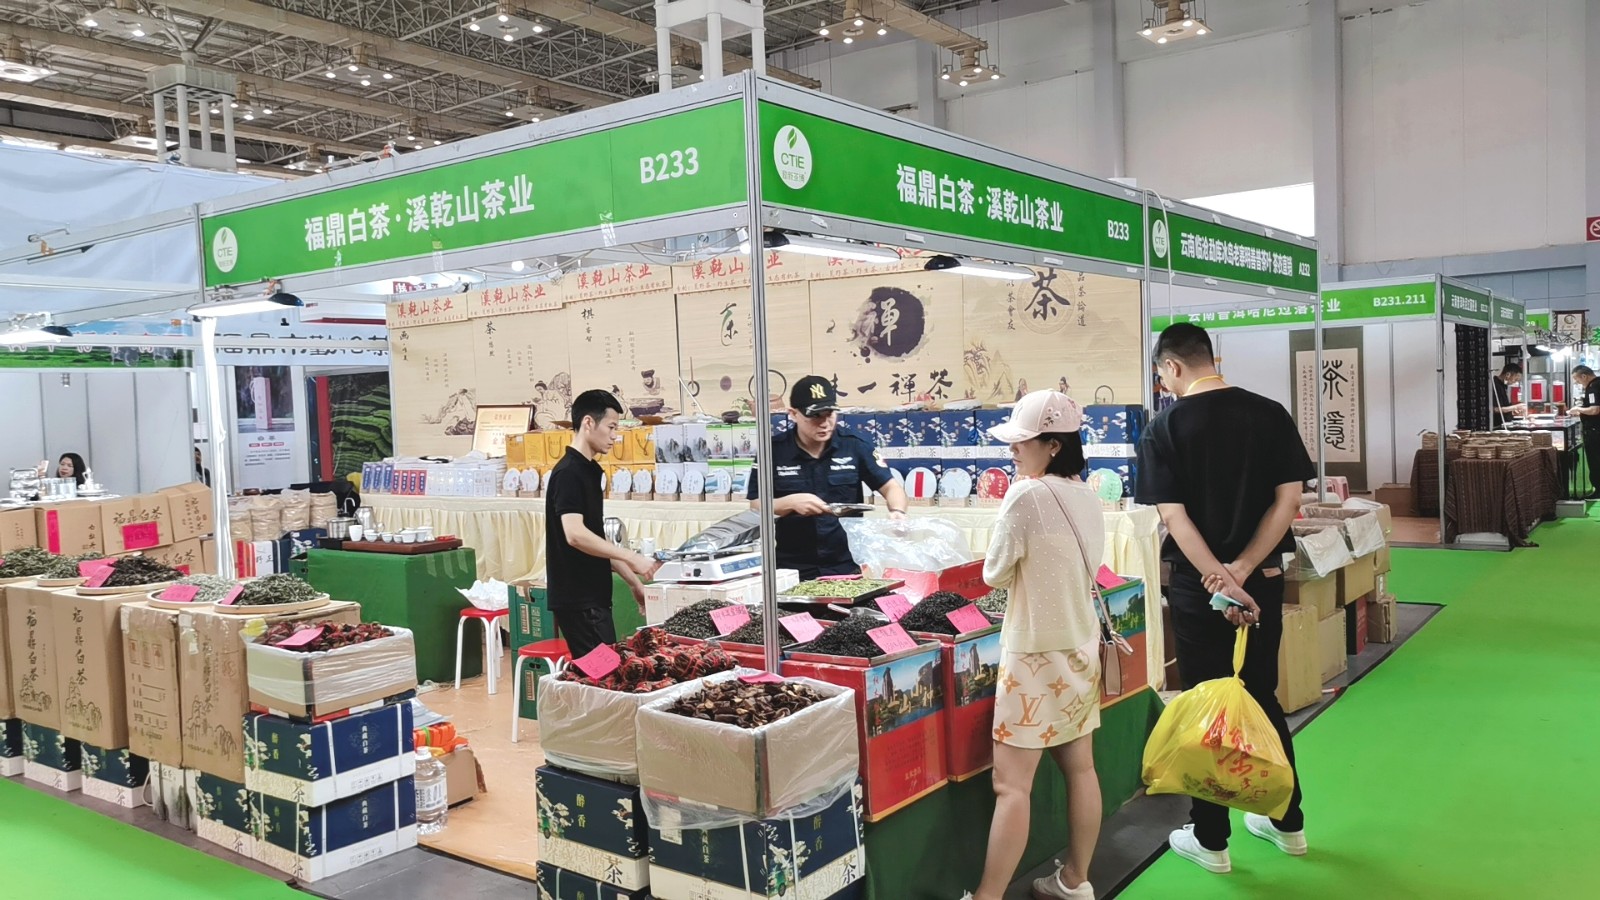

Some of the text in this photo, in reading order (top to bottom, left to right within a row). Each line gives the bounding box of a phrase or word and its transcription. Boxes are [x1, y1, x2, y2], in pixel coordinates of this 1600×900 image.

[640, 147, 699, 184] B233
[896, 162, 1064, 232] 福鼎白茶·溪乾山茶业
[304, 173, 535, 252] 福鼎白茶·溪乾山茶业
[1107, 219, 1130, 242] B233
[1298, 262, 1311, 277] A232
[1023, 267, 1071, 321] 茶
[1373, 293, 1427, 308] B231.211
[810, 383, 827, 399] NY
[604, 854, 623, 884] 茶
